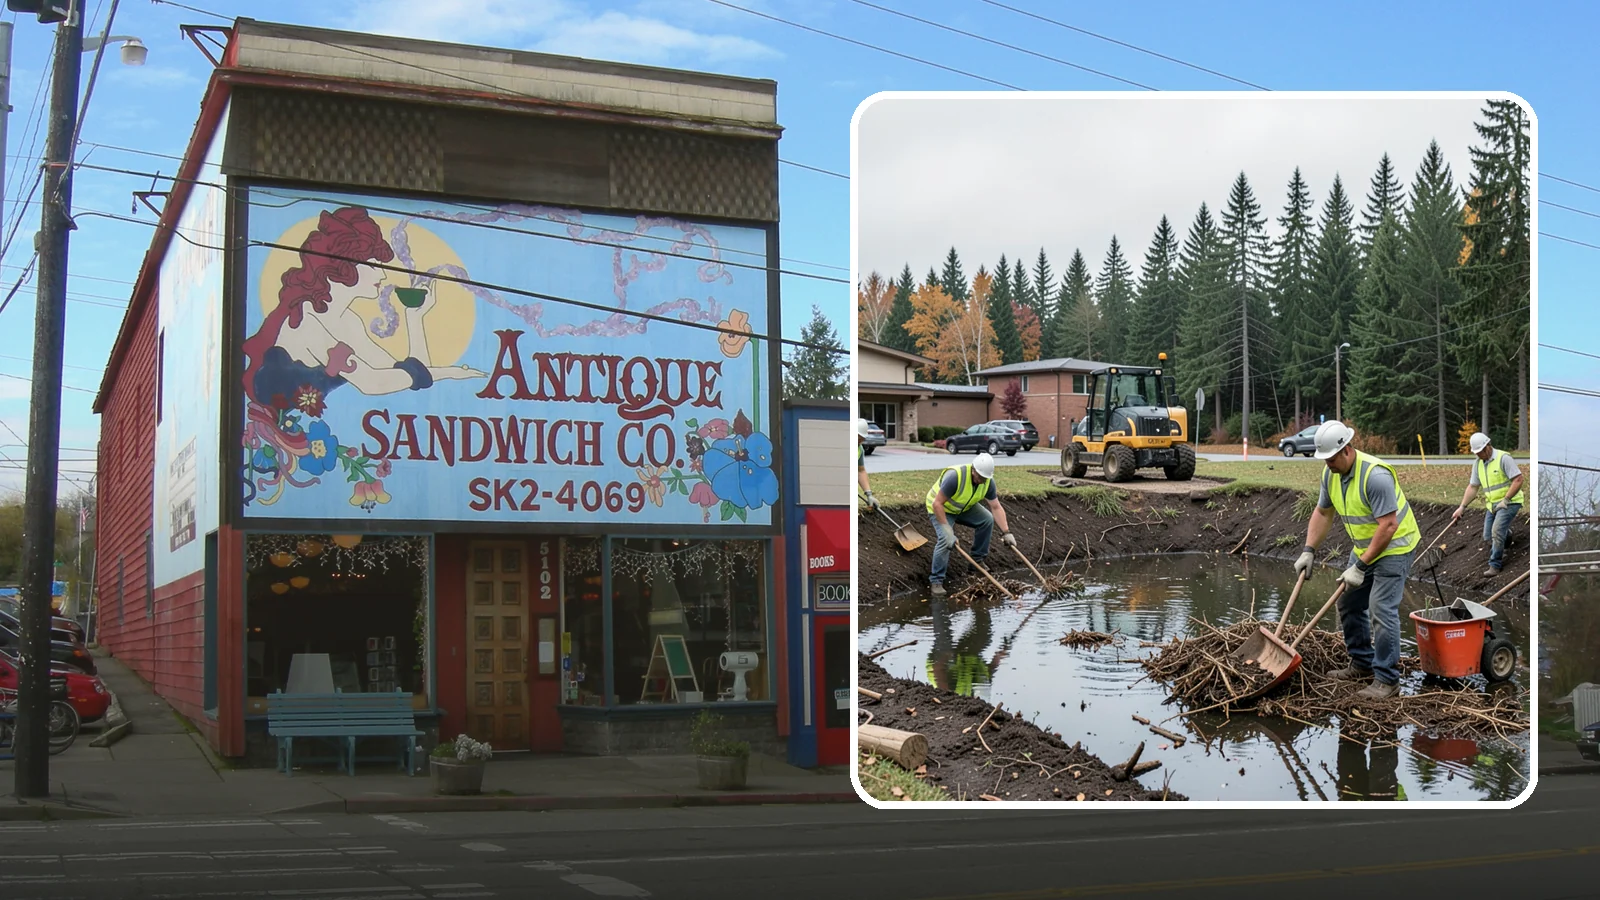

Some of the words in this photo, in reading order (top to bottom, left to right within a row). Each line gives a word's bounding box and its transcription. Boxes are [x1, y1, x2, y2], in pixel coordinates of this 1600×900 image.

[476, 329, 723, 420] ANTIQUE
[361, 408, 604, 469] SANDWICH
[618, 421, 685, 469] CO.
[469, 477, 645, 513] SK2-4069
[539, 541, 552, 600] 5102
[809, 555, 835, 569] BOOKS
